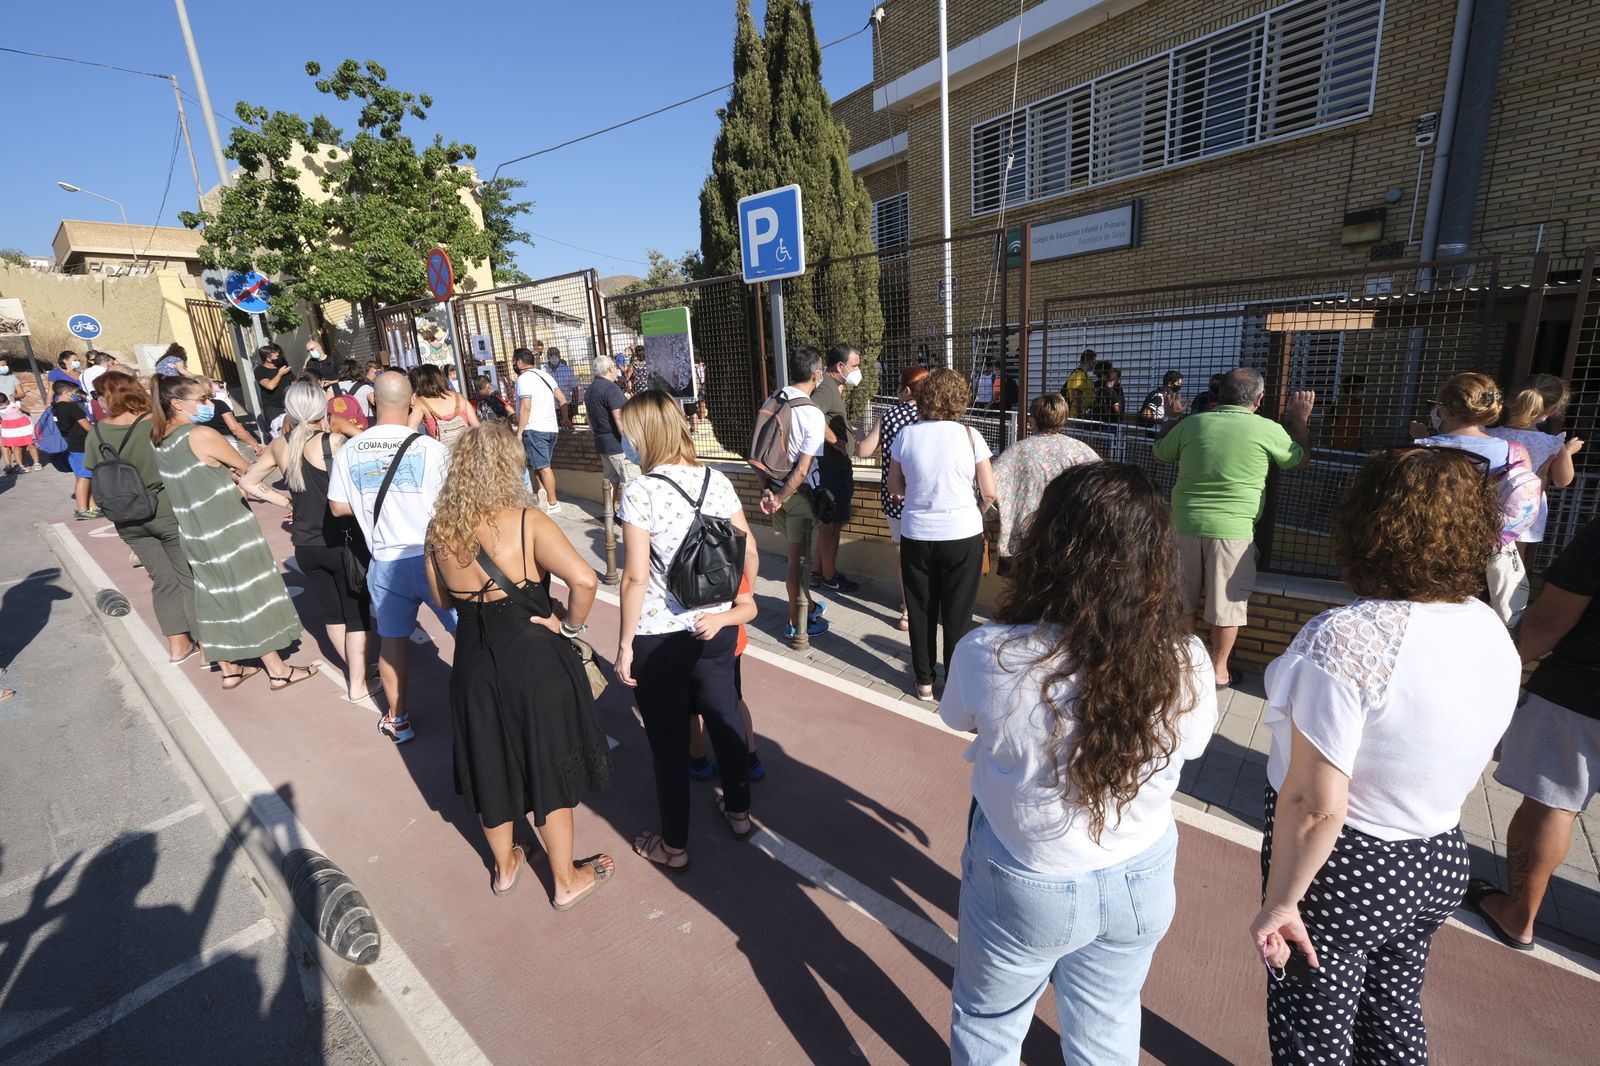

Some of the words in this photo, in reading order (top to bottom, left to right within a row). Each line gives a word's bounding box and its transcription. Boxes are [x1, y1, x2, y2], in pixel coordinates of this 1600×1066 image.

[747, 207, 779, 267] P
[1056, 229, 1080, 240] Educación
[1081, 225, 1098, 235] Infantil
[1104, 220, 1126, 230] Primaria
[1112, 231, 1126, 241] Goya
